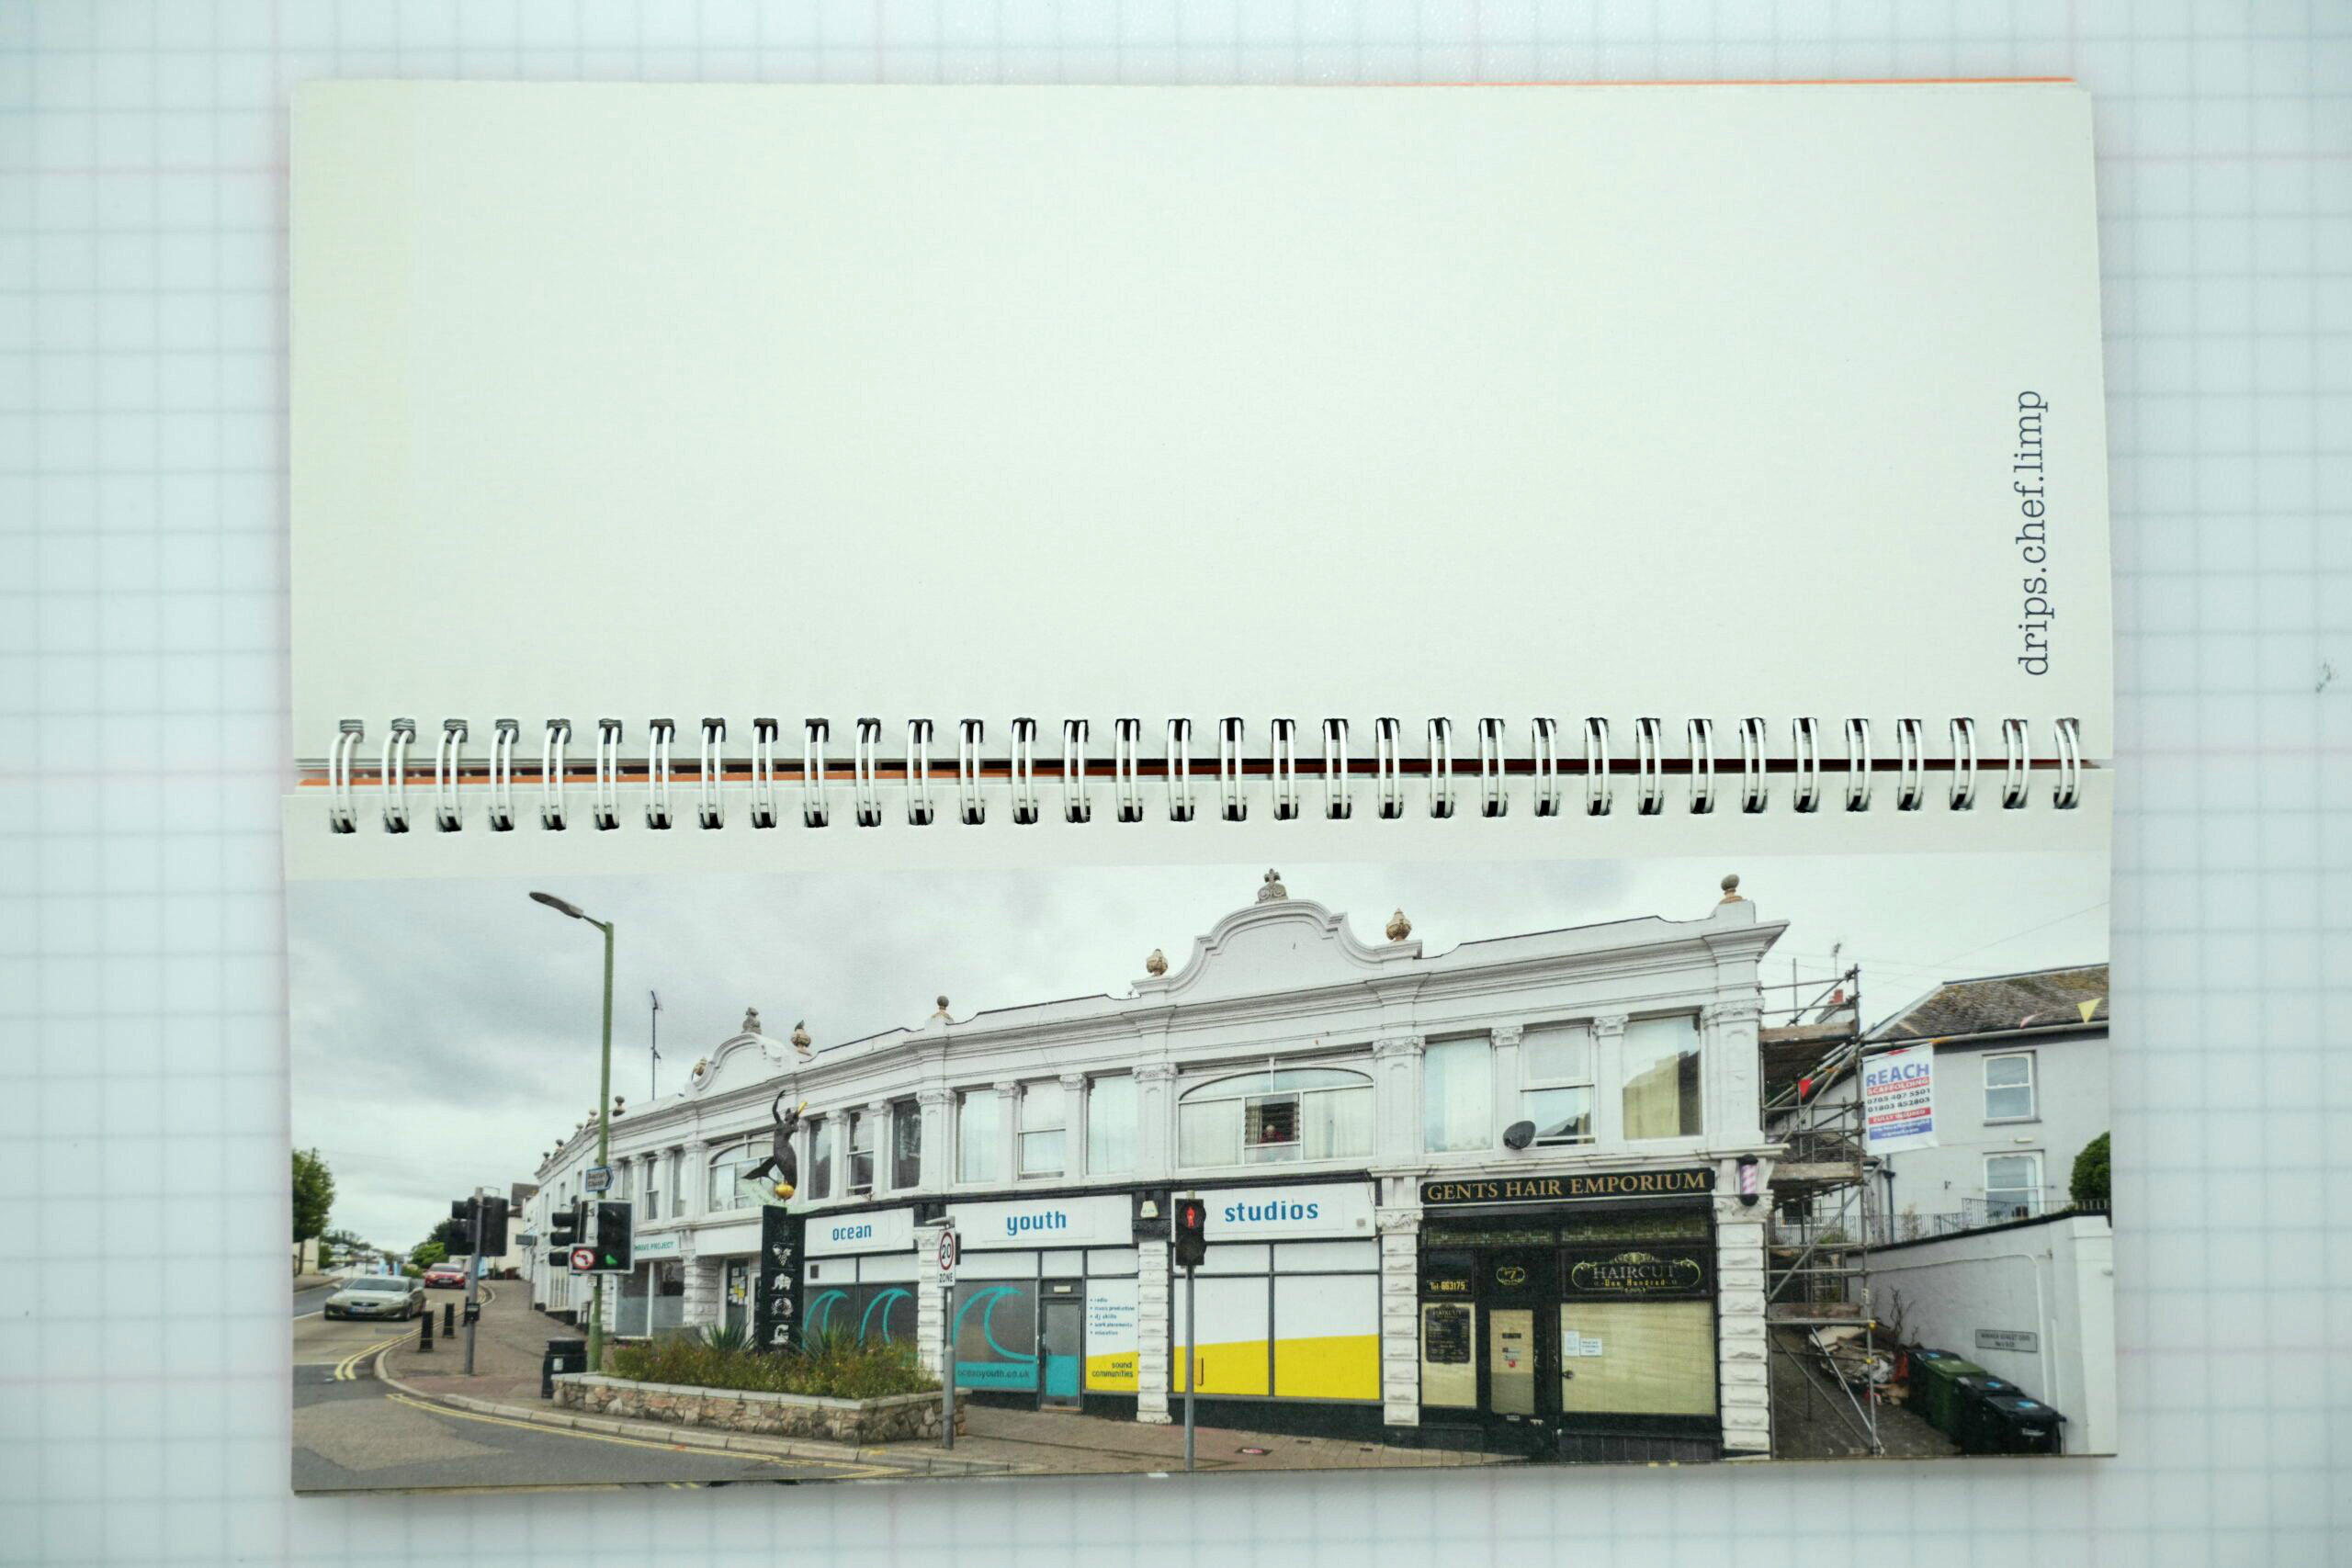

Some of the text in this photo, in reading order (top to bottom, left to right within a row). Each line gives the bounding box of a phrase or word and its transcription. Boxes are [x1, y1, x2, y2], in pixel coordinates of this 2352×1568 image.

[2013, 390, 2054, 676] drips.chef.limp
[1866, 1063, 1929, 1088] REACH
[1867, 1077, 1929, 1095] SCAFFOLDING
[1427, 1171, 1706, 1201] GENTS HAIR EMPORIUM
[1225, 1201, 1318, 1223] studios
[1006, 1211, 1067, 1236] youth
[831, 1224, 872, 1241] ocean
[650, 1241, 674, 1249] PROJECT
[942, 1243, 952, 1259] 20
[939, 1272, 953, 1283] ZONE
[1593, 1266, 1674, 1279] HAIRCUT
[1091, 1369, 1134, 1378] communities
